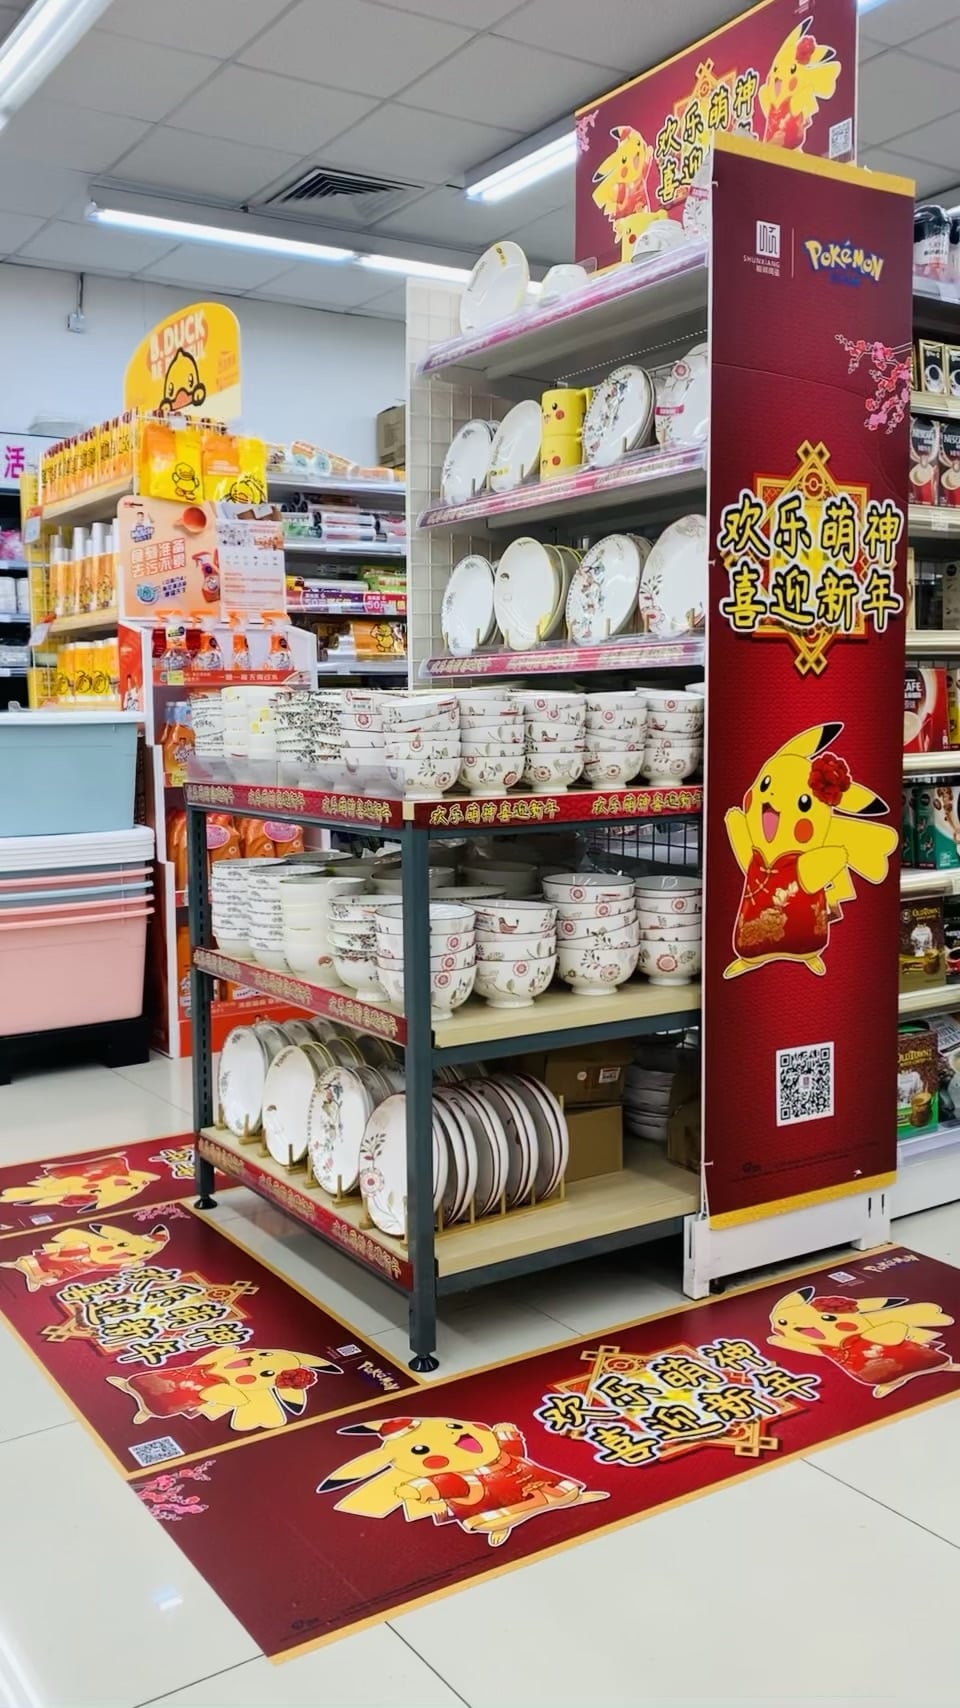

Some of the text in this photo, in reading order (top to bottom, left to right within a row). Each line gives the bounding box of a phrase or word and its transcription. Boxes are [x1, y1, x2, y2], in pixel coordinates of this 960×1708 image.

[656, 70, 758, 158] 欢乐萌神
[149, 309, 206, 363] B.DUCK
[4, 445, 25, 478] 活
[718, 488, 904, 566] 欢乐萌神
[719, 560, 904, 634] 喜迎新年
[429, 799, 561, 827] 欢乐萌神喜迎新年
[534, 1338, 768, 1433] 欢乐萌神
[584, 1367, 822, 1466] 喜迎新年
